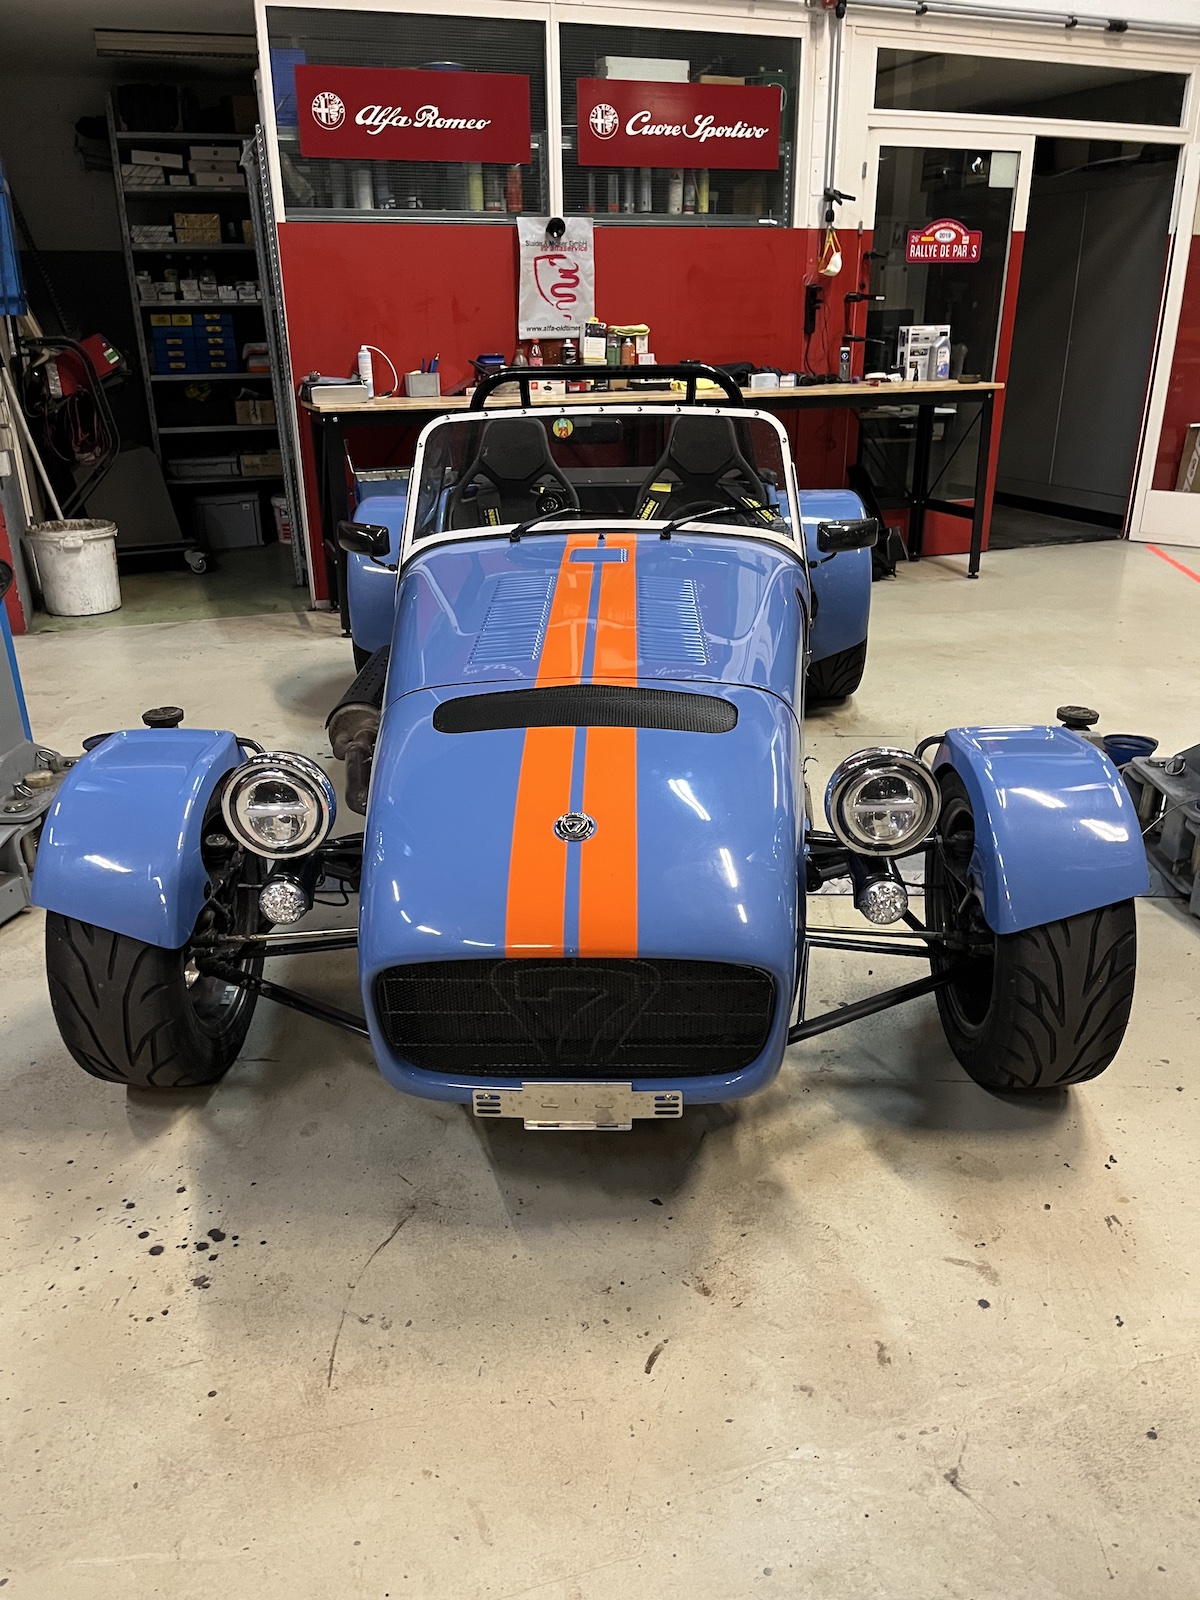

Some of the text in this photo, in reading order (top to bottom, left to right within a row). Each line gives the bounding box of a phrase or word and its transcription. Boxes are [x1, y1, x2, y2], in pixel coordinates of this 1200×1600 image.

[355, 105, 491, 135] Alfa Romeo
[625, 110, 769, 142] Cuore Sportivo
[910, 244, 938, 257] RALLYE
[940, 244, 950, 257] DE
